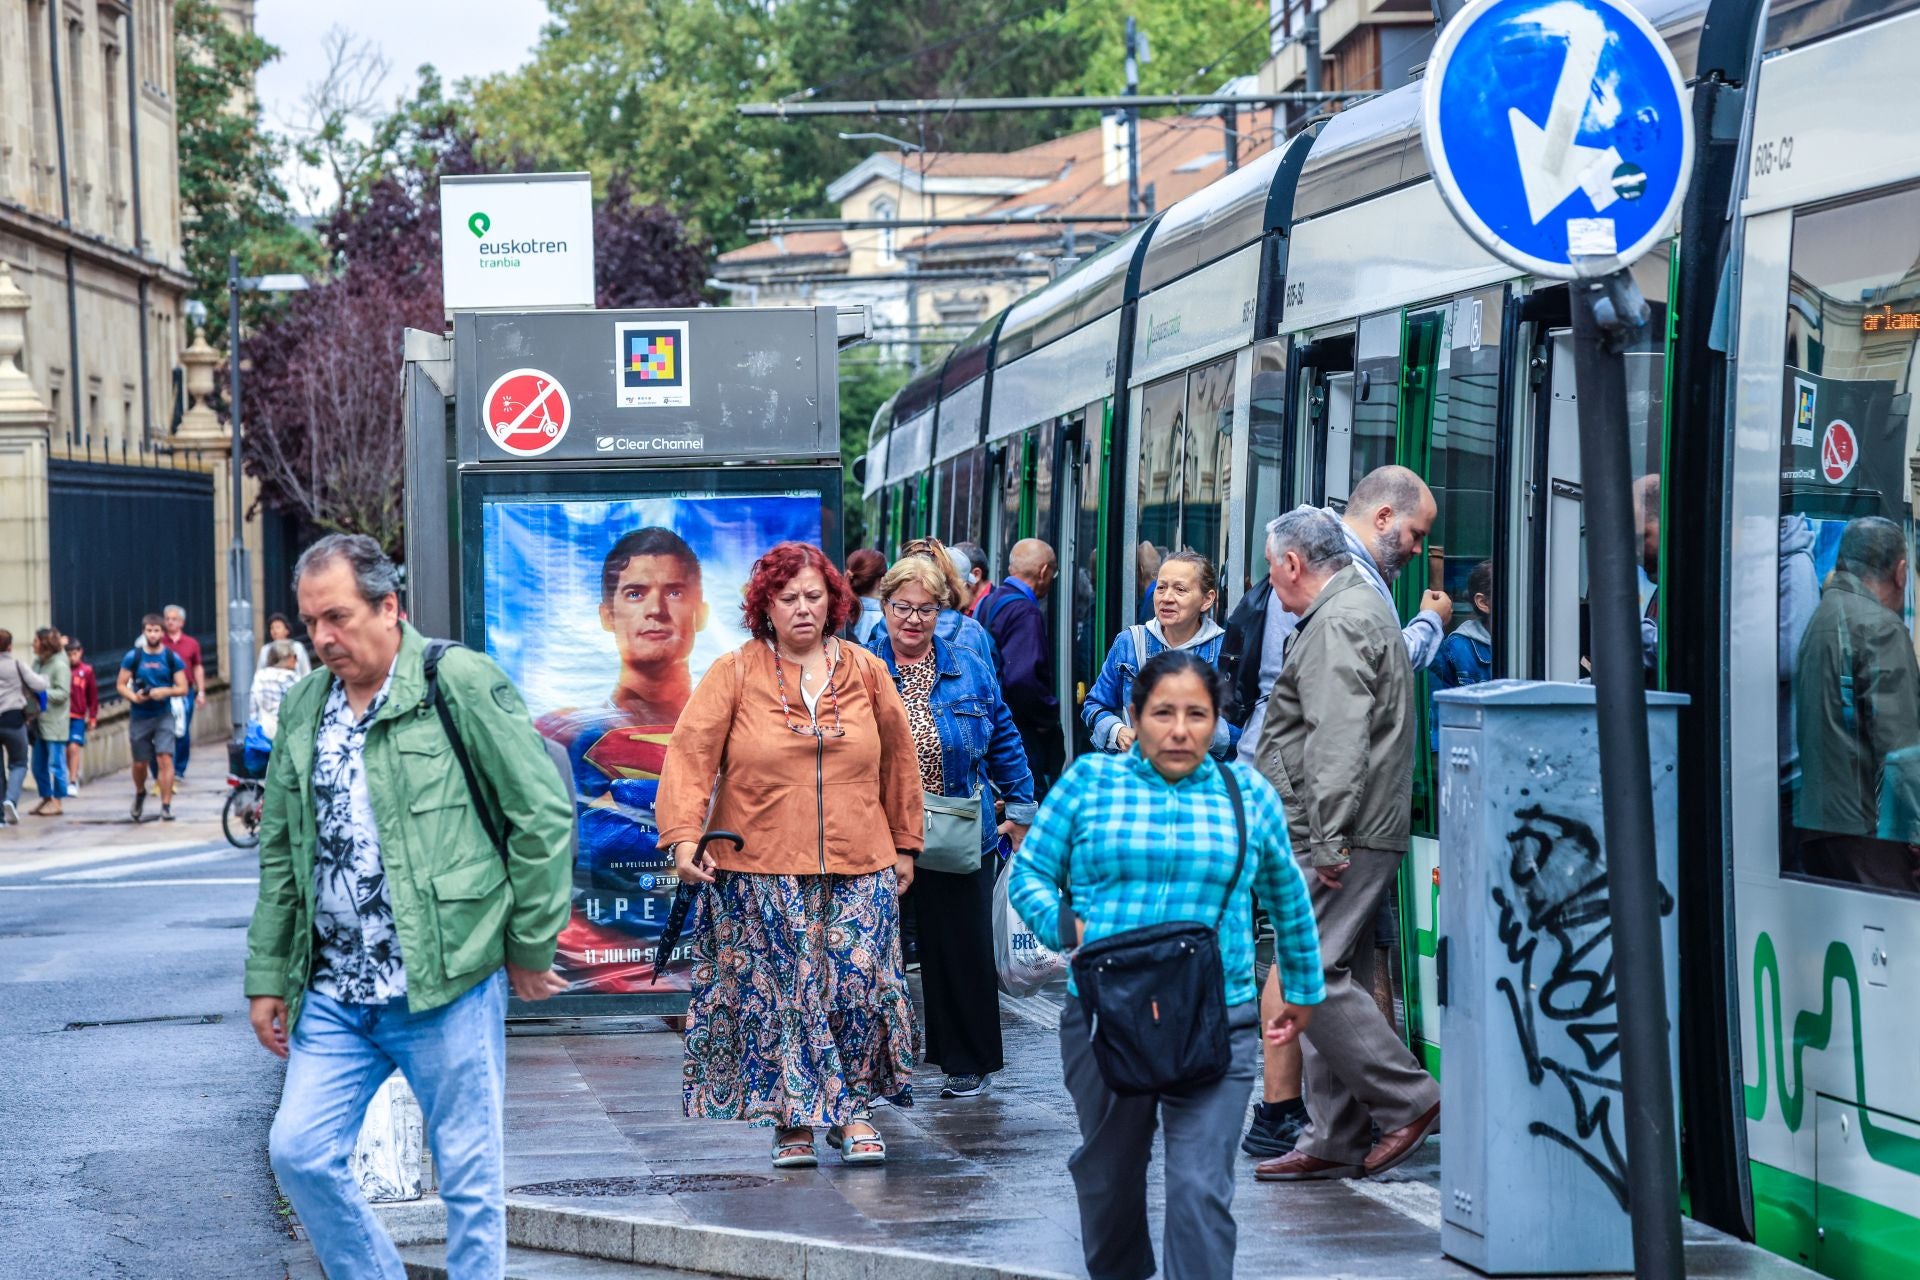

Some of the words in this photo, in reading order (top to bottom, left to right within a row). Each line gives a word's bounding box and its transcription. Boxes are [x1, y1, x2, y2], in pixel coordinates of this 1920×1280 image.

[1755, 136, 1794, 177] 605-C2
[479, 238, 568, 255] euskotren
[479, 256, 521, 268] tranbia
[615, 437, 650, 450] Clear
[651, 437, 704, 450] Channel
[585, 949, 596, 963] 11
[600, 948, 641, 964] JULIO
[645, 947, 681, 962] SO
